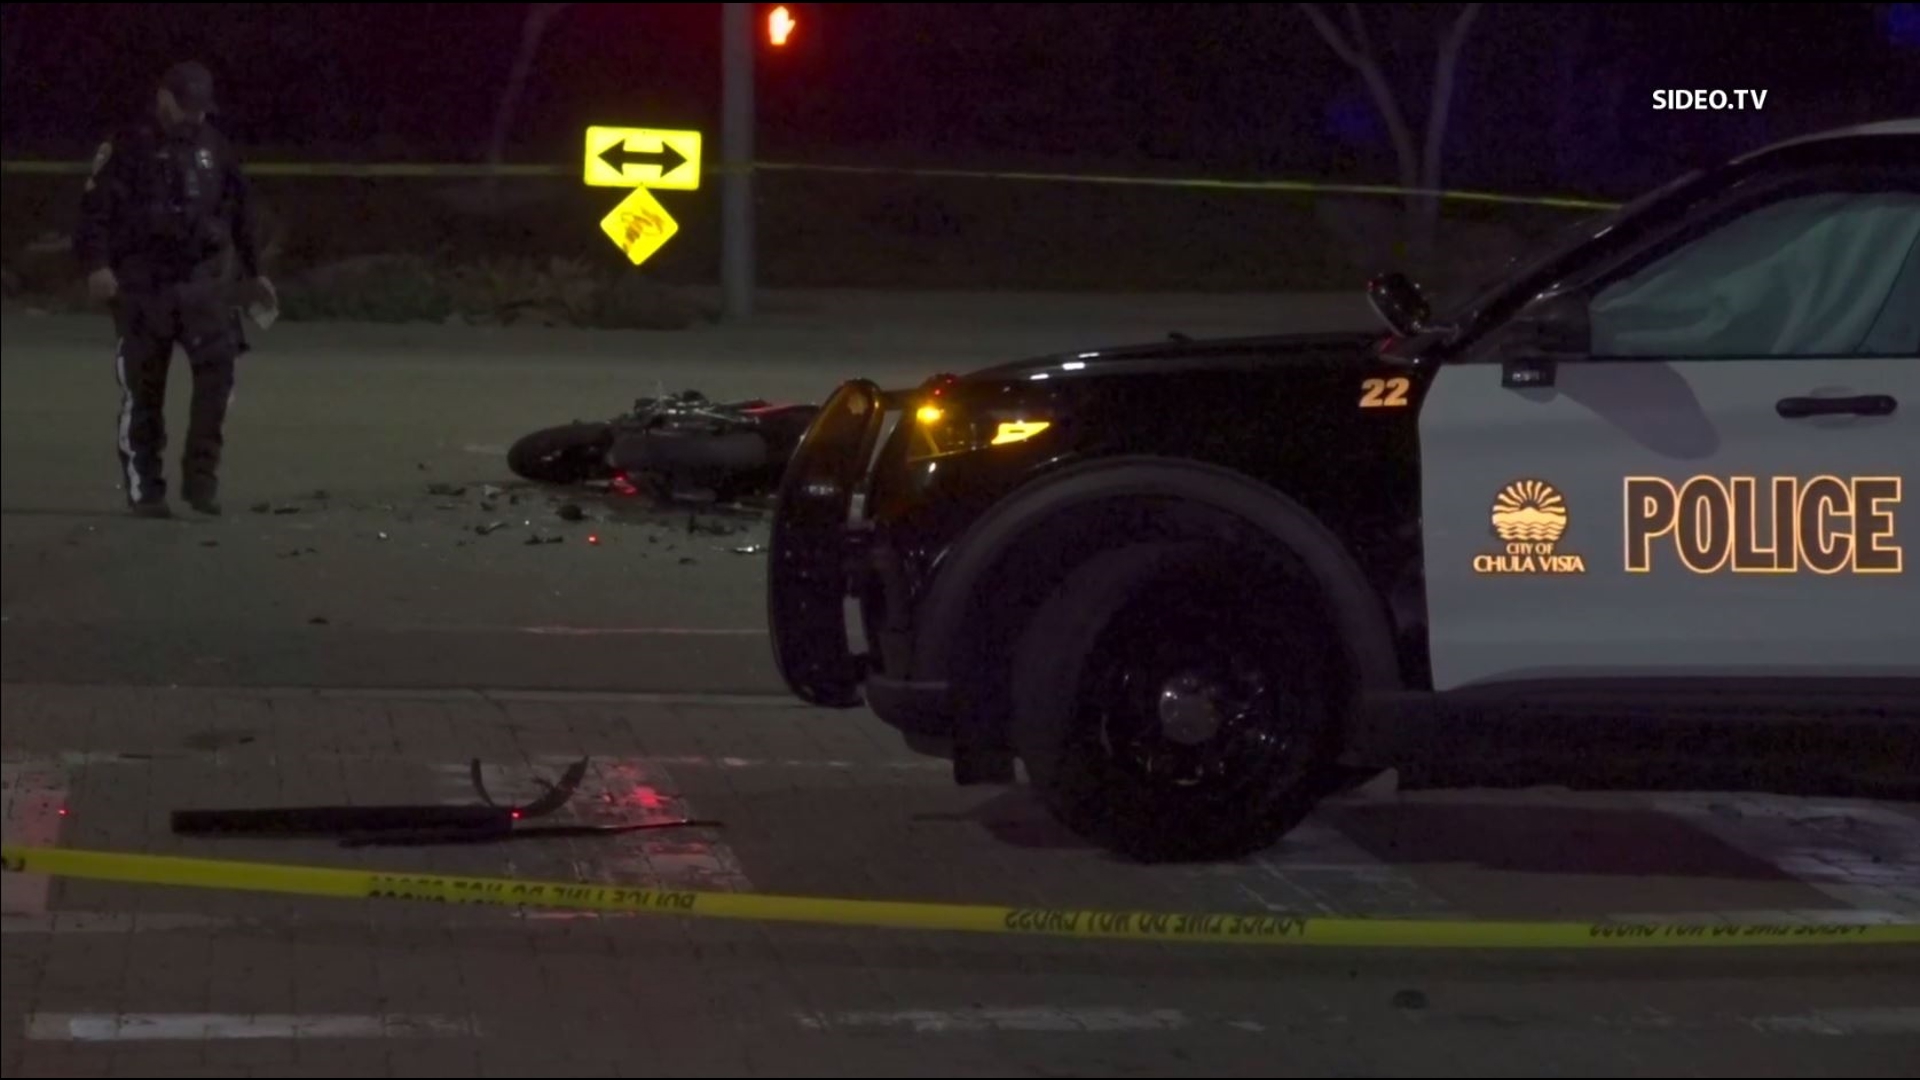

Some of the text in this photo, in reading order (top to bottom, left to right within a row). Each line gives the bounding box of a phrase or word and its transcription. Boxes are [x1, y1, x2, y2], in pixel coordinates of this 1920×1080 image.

[1359, 377, 1410, 407] 22
[1624, 474, 1903, 574] POLICE
[1506, 542, 1554, 555] CITY OF
[1473, 555, 1585, 572] CHULA VISTA
